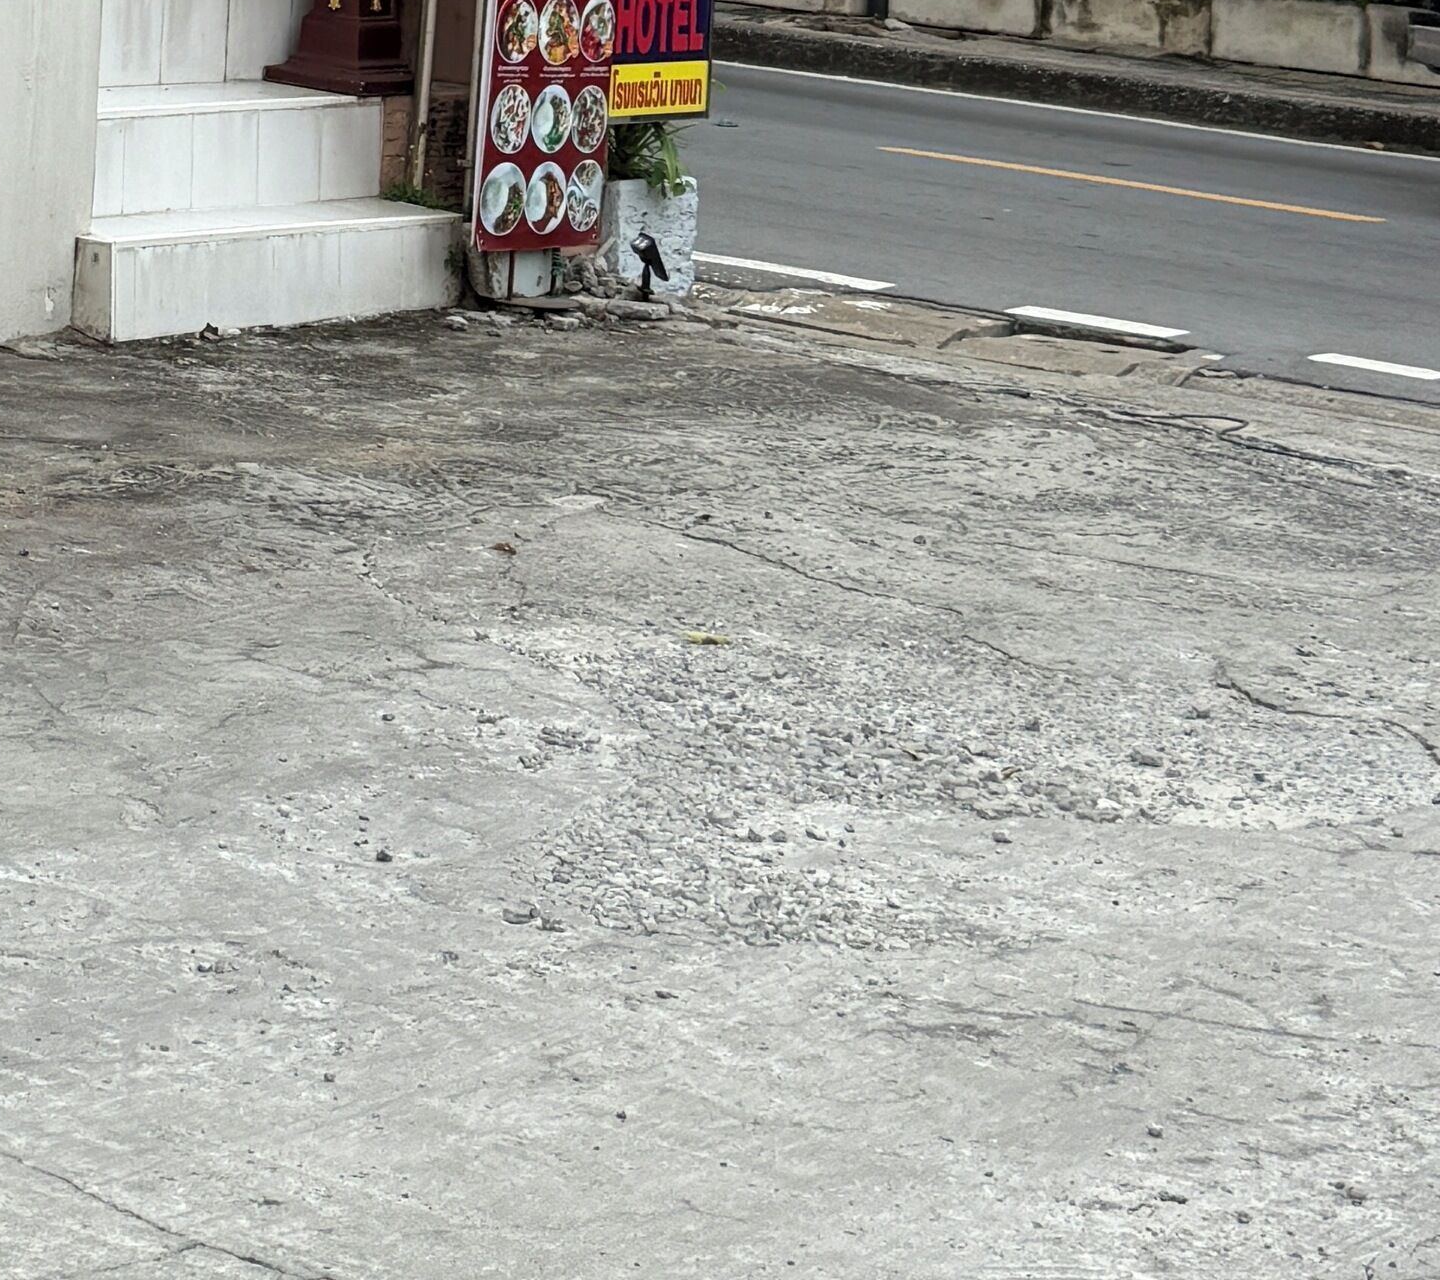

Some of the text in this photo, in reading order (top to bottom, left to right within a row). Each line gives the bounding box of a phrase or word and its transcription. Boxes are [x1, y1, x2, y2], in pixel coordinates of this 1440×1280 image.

[611, 69, 668, 110] โรงแรมวิน
[670, 78, 702, 106] บางนา
